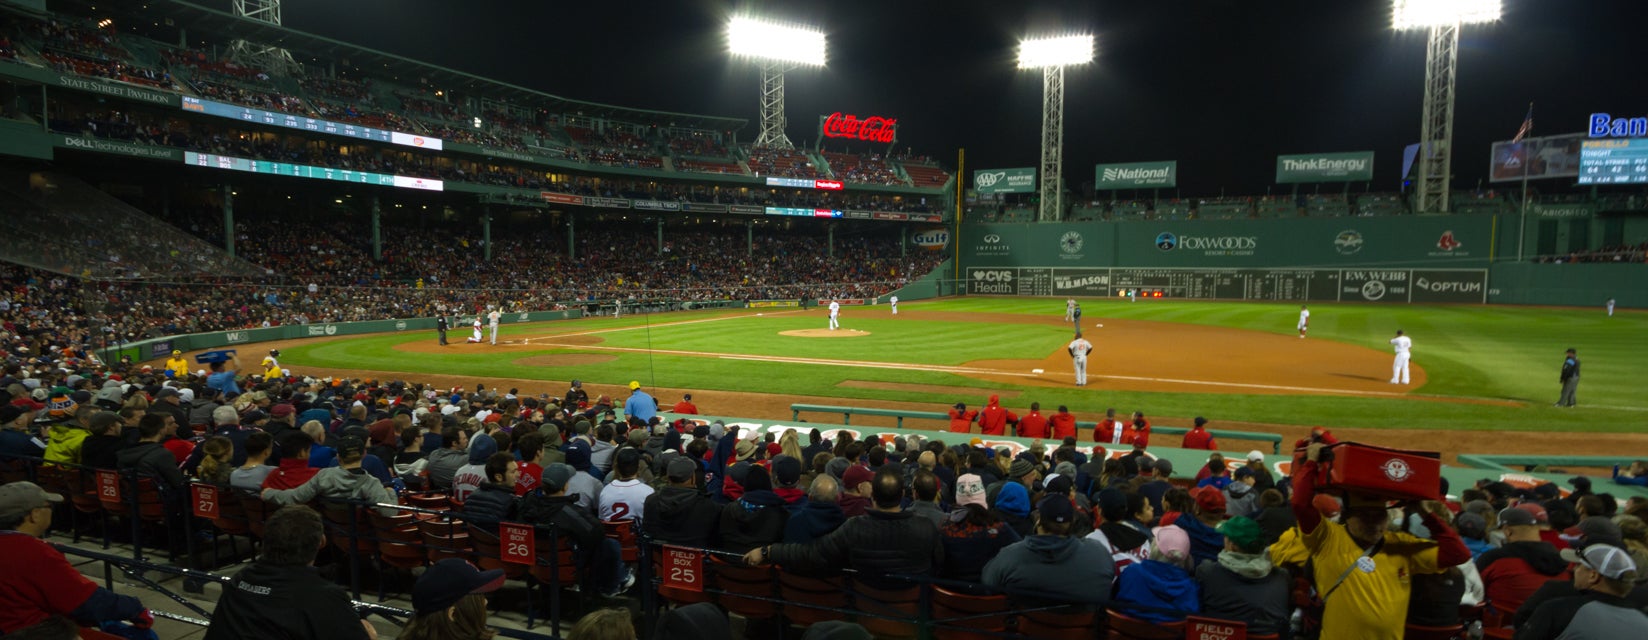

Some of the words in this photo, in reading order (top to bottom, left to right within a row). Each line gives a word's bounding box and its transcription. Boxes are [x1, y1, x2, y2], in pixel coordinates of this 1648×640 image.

[60, 76, 90, 90] STATE
[91, 83, 124, 96] STREET
[127, 89, 169, 104] PAVILION
[823, 111, 897, 143] Coca-Cola
[1583, 139, 1629, 149] PORCELLO
[150, 148, 172, 157] Level
[1582, 149, 1612, 158] TONIGHT
[980, 173, 995, 185] AAA
[1117, 167, 1169, 181] National
[1541, 207, 1588, 217] ABIOMED
[913, 232, 948, 243] Gulf
[1179, 235, 1257, 249] FOXWOODS
[986, 270, 1012, 282] CVS
[1369, 272, 1406, 281] WEBB
[974, 281, 1012, 293] Health
[1431, 282, 1481, 292] OPTUM
[103, 485, 116, 497] 28
[200, 500, 214, 512] 27
[611, 502, 629, 520] 2
[507, 527, 528, 536] FIELD
[508, 542, 529, 557] 26
[670, 550, 695, 560] FIELD
[673, 558, 692, 567] BOX
[671, 567, 695, 583] 25
[1196, 623, 1234, 635] FIELD
